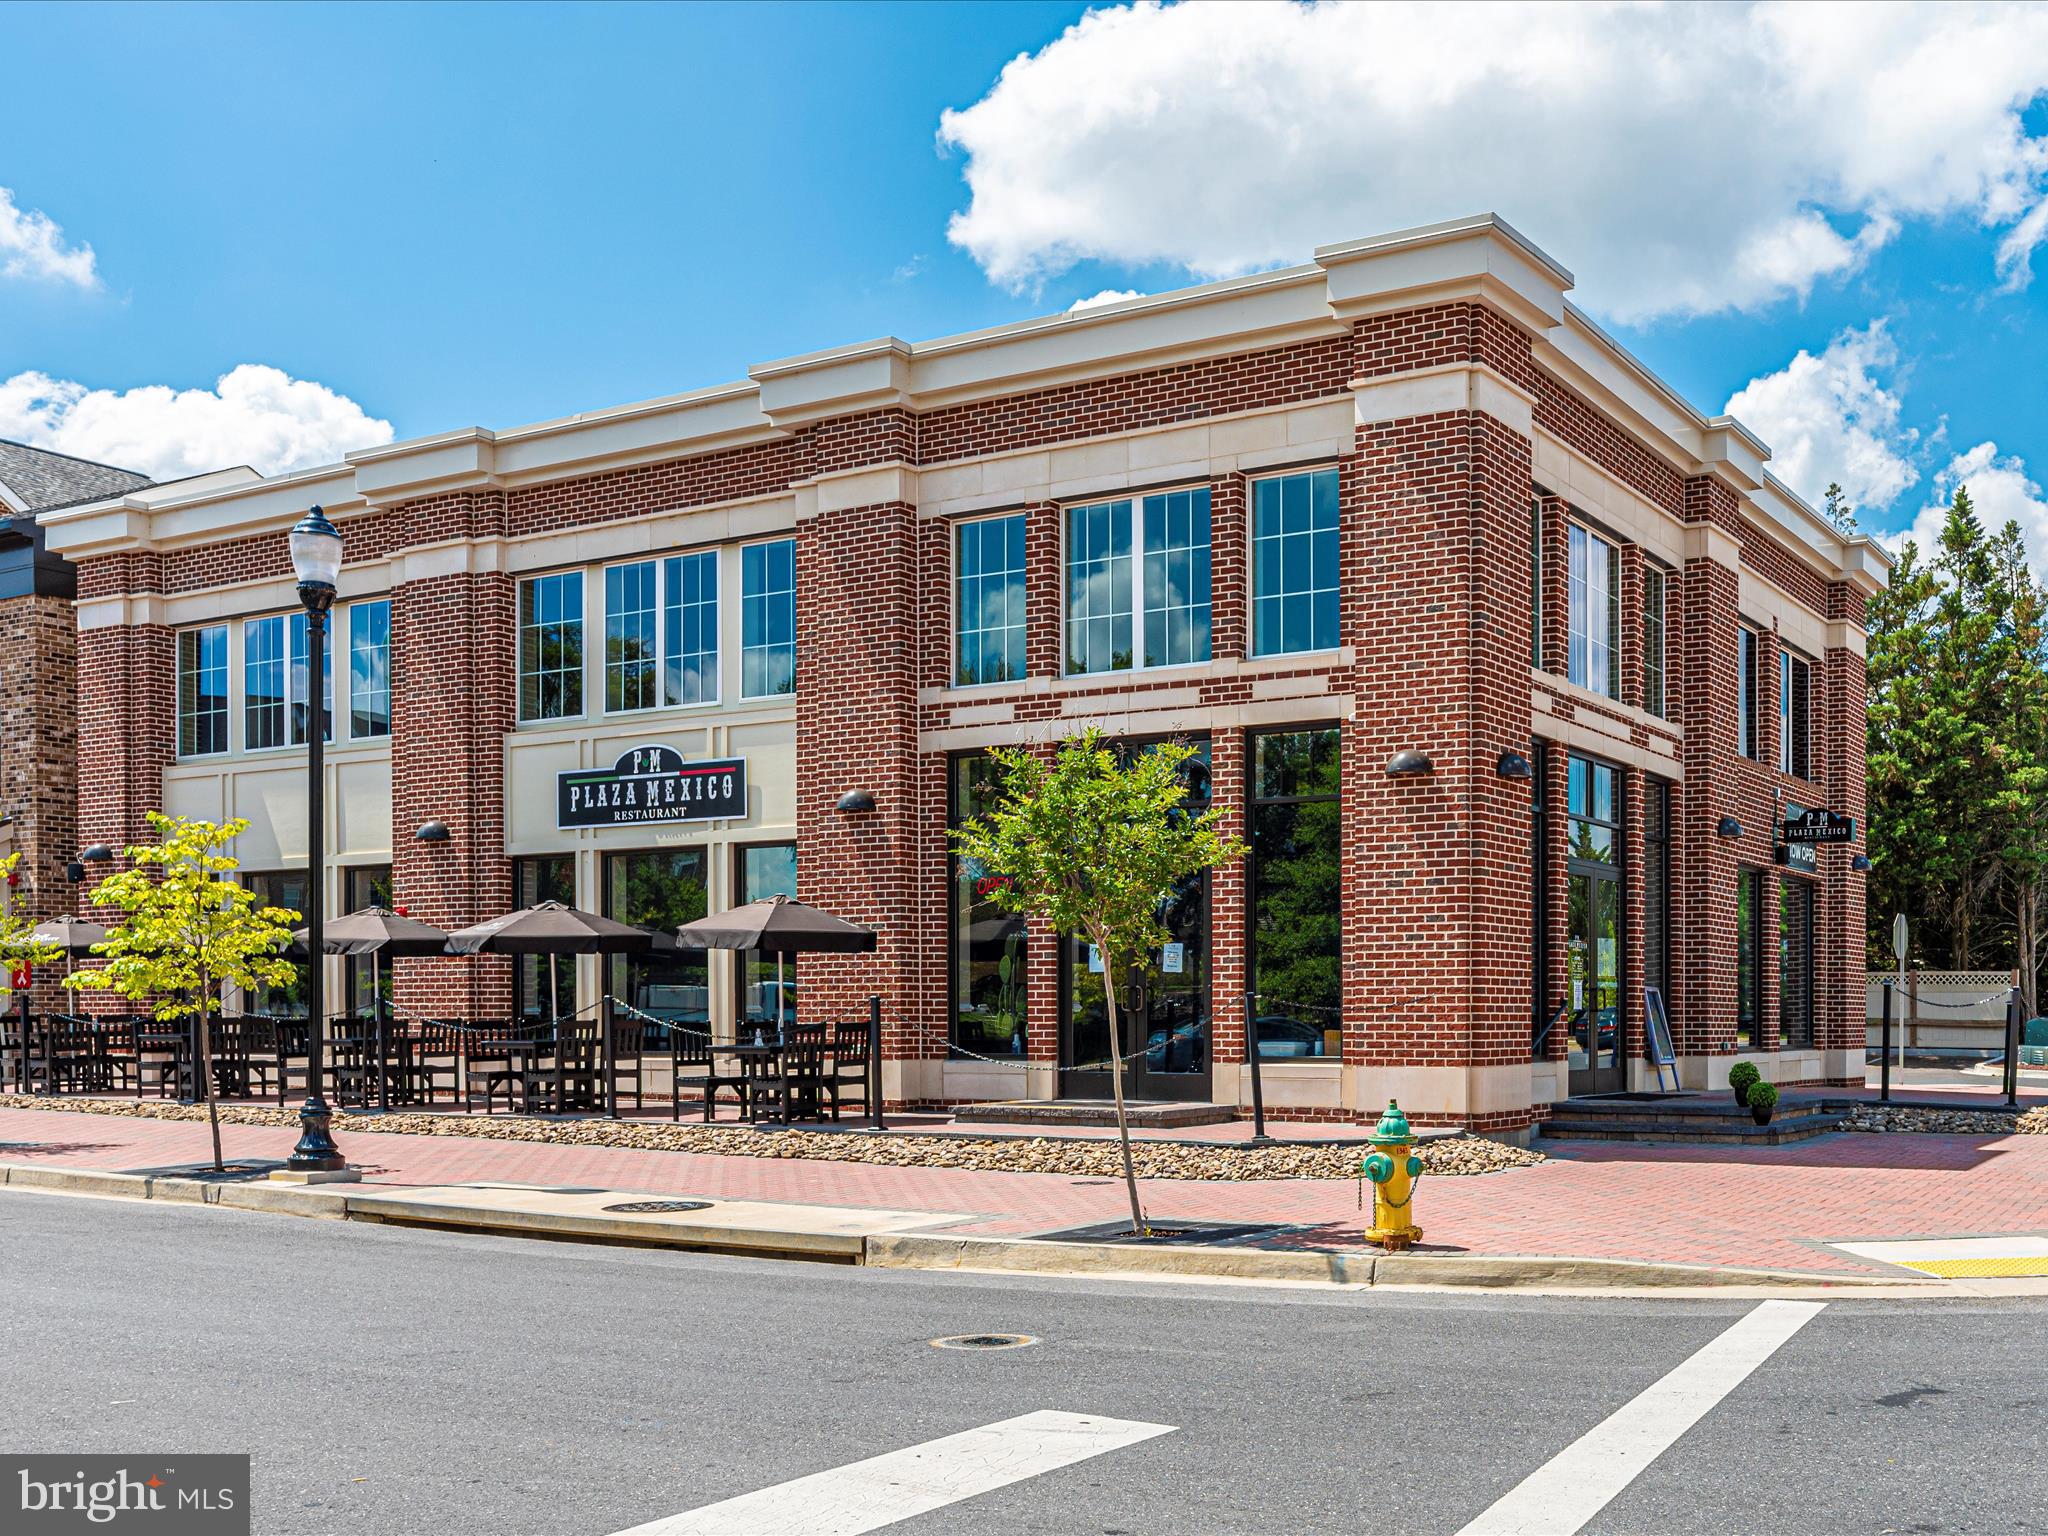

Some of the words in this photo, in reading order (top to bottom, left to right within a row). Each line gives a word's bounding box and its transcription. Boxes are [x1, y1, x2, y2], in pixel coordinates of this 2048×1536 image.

[570, 783, 637, 812] PLAZA
[646, 774, 733, 807] MEXICO
[614, 806, 687, 821] RESTAURANT
[1788, 829, 1813, 837] PLAZA
[1816, 827, 1847, 837] MEXICO
